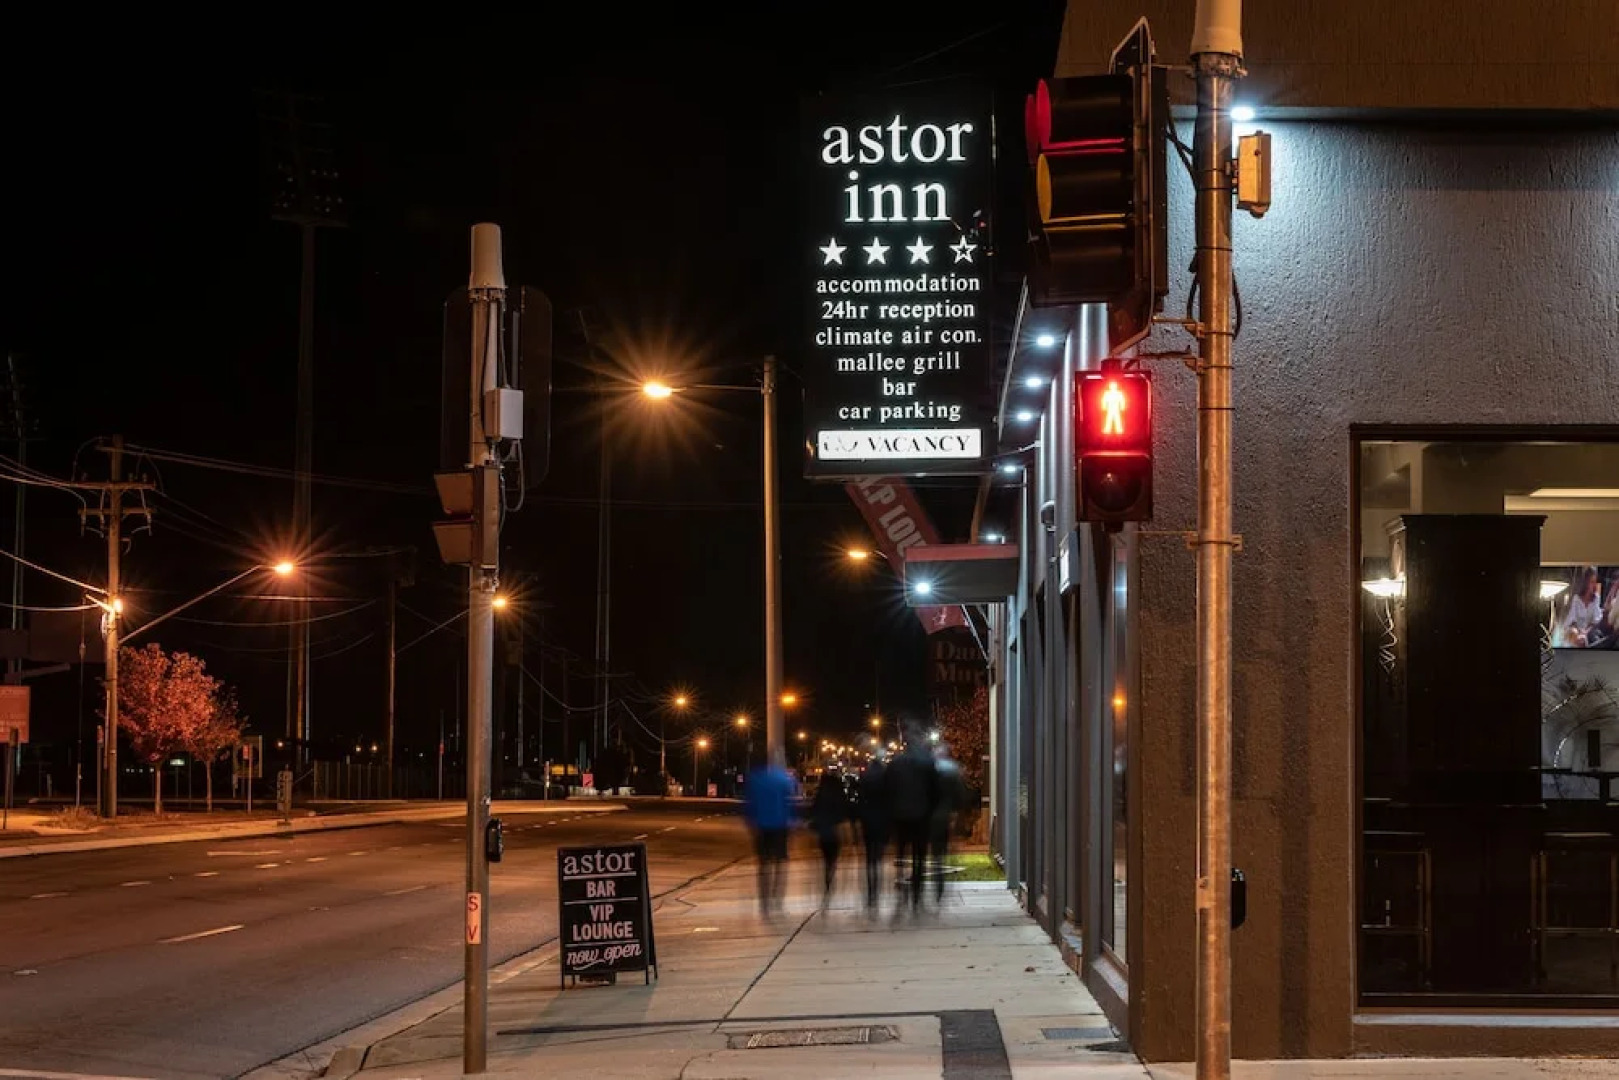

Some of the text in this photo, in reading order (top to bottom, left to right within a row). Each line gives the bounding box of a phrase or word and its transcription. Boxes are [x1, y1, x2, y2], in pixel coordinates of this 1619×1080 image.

[821, 114, 974, 164] astor
[844, 169, 952, 223] inn
[816, 273, 981, 293] accommodation
[822, 299, 975, 323] 24hr reception
[815, 325, 983, 345] climate air con.
[837, 350, 961, 375] mallee grill
[882, 376, 917, 396] bar
[838, 400, 961, 424] car parking
[868, 435, 971, 452] VACANCY
[563, 849, 636, 875] astor
[585, 880, 616, 898] BAR
[588, 904, 615, 922] VIP
[572, 921, 634, 942] LOUNGE
[566, 943, 643, 967] now open
